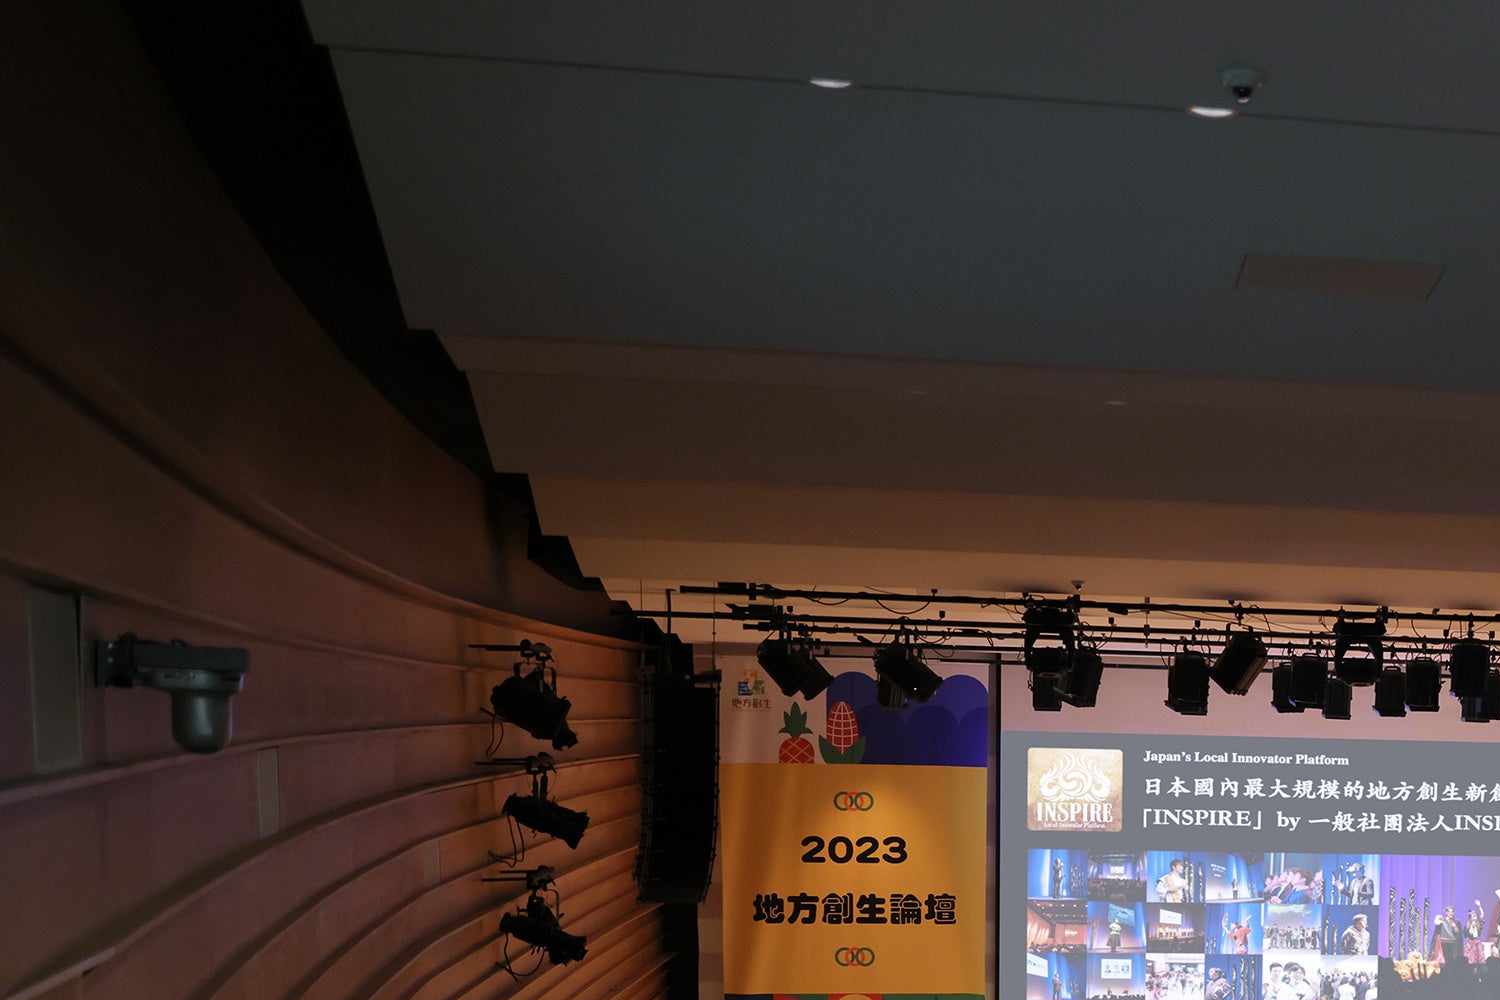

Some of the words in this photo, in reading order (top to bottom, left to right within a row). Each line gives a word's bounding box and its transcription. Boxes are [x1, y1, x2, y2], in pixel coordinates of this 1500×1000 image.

[1194, 752, 1228, 763] Local
[1232, 753, 1293, 764] Innovator
[1295, 754, 1350, 766] Platform
[1037, 801, 1113, 823] INSPIRE
[1277, 811, 1301, 831] by
[801, 836, 908, 864] 2023
[752, 892, 957, 925] 地方創生論壇
